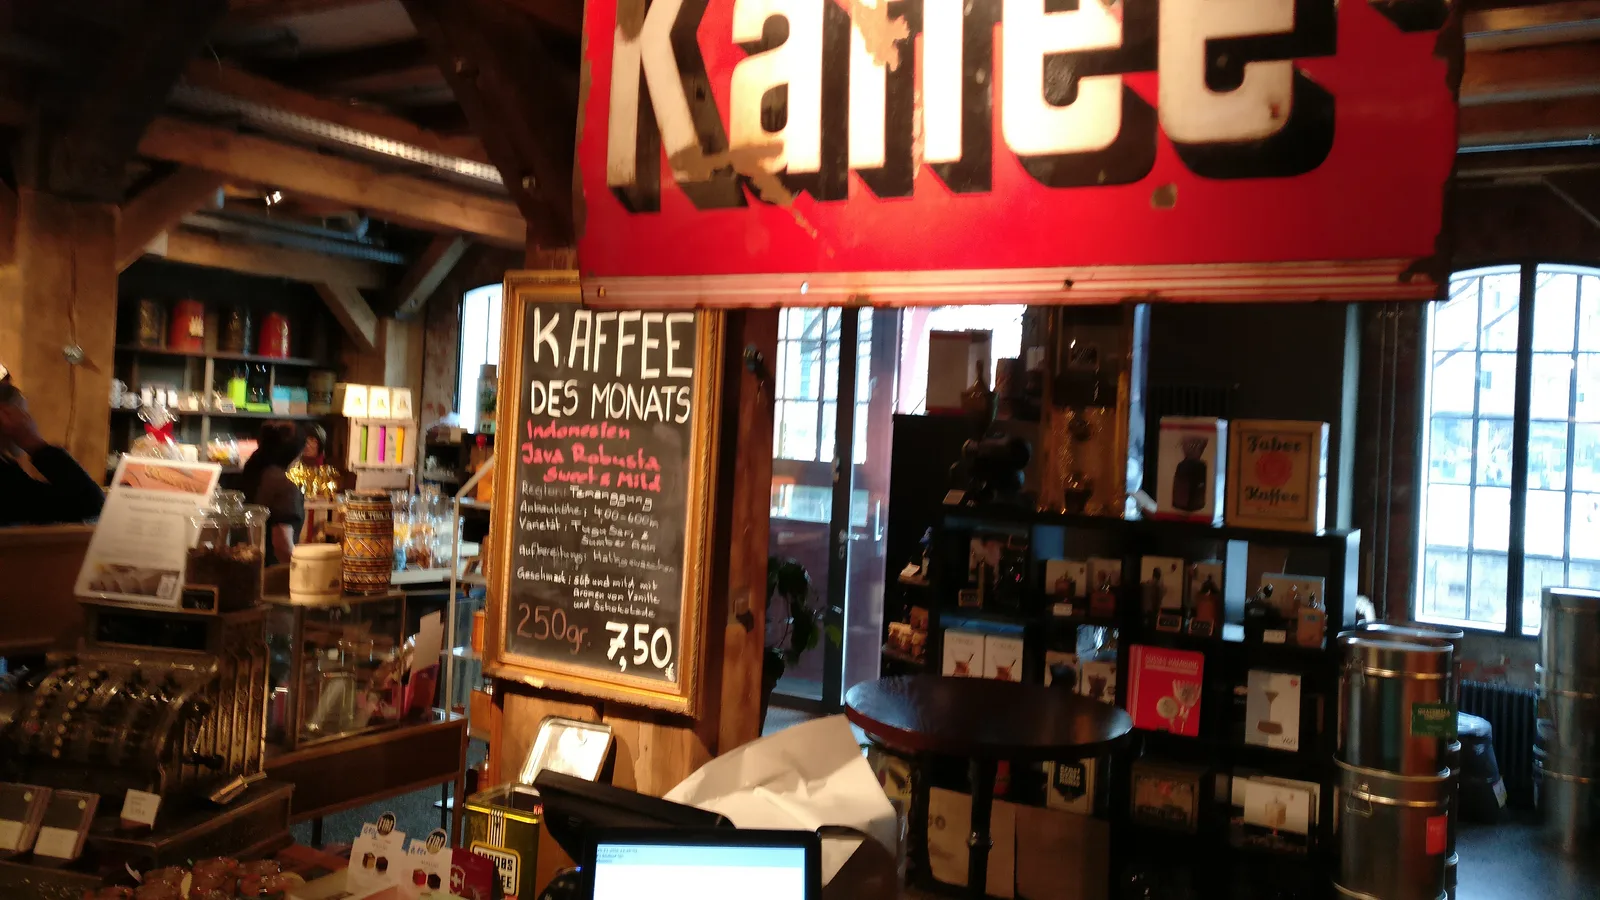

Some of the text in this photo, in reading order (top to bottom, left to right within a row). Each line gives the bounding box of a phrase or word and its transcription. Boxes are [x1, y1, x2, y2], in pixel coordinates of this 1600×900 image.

[533, 307, 695, 379] KAFFEE
[530, 379, 691, 424] DES MONATS
[527, 419, 630, 440] Indonesien
[571, 442, 661, 471] Robusta
[543, 466, 597, 484] Sweet
[592, 574, 610, 588] und
